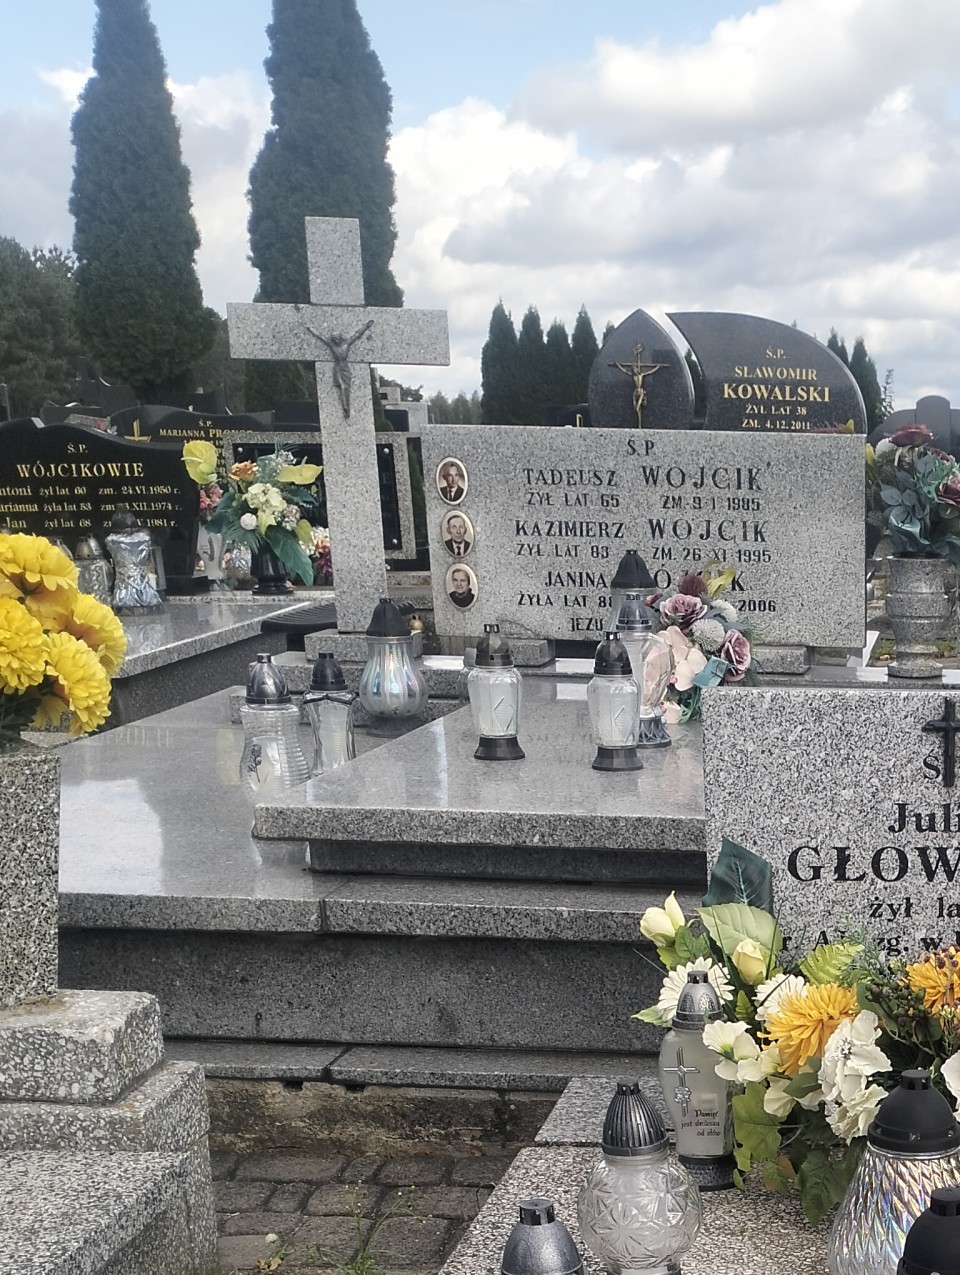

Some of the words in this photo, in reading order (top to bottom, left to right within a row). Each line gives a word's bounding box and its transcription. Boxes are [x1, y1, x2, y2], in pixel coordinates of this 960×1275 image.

[723, 383, 830, 402] KOWALSKI
[772, 405, 791, 415] LAT
[796, 406, 807, 415] 38
[159, 428, 205, 438] MARIANNA
[17, 460, 144, 478] WÓJCIKOWIE
[523, 468, 618, 487] TADEUSZ
[0, 485, 32, 496] ntoni
[56, 486, 70, 496] lat
[74, 486, 87, 495] 60
[98, 487, 117, 496] zm.
[0, 502, 38, 513] arianna
[64, 503, 77, 513] lat
[601, 494, 620, 508] 65
[5, 516, 27, 529] Jan
[61, 518, 74, 528] lat
[79, 518, 92, 527] 68
[515, 519, 625, 539] KAZIMIERZ
[555, 544, 581, 558] LAT
[590, 545, 609, 559] 83
[737, 548, 772, 563] 1995
[545, 571, 608, 588] JANINA
[563, 594, 588, 607] LAT
[737, 599, 777, 612] 2006
[570, 617, 603, 632] JEZU
[869, 896, 914, 922] żył
[920, 937, 943, 951] w
[681, 1121, 692, 1129] jest
